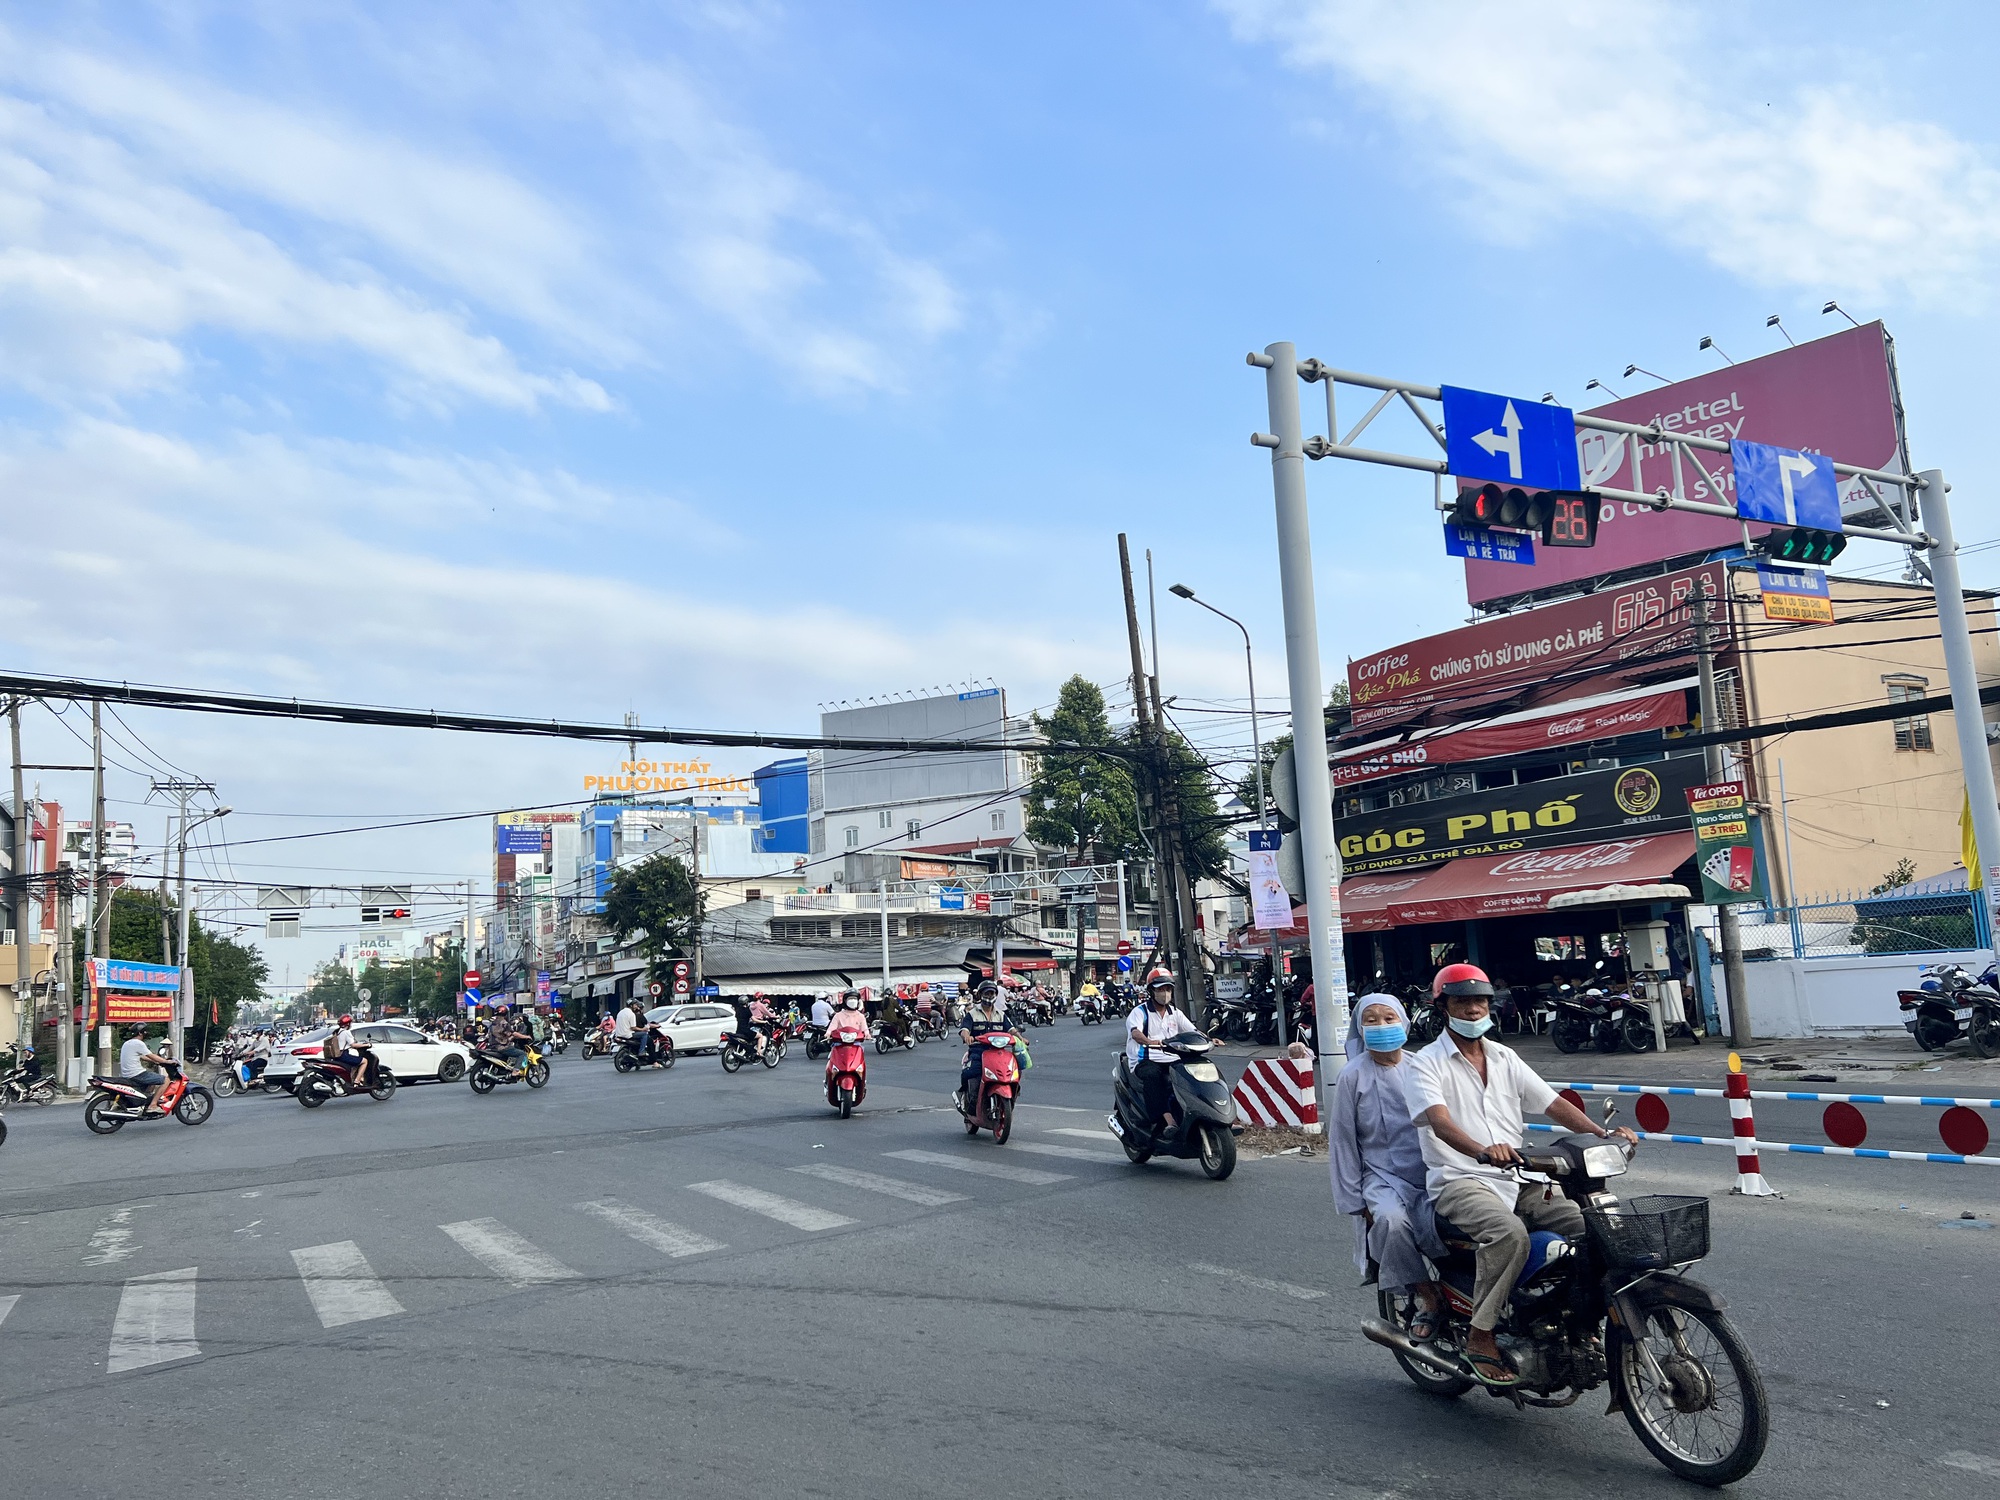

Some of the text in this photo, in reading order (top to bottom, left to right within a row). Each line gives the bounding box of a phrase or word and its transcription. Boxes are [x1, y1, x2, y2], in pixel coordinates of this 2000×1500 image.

[1552, 499, 1588, 540] 26
[1497, 547, 1517, 561] TRÁI
[1429, 657, 1472, 682] CHÚNG
[1473, 649, 1493, 671] TÔI
[1496, 643, 1512, 666] SỬ
[1514, 638, 1551, 664] DỤNG
[1554, 629, 1576, 652] CÀ
[1578, 621, 1604, 646] PHÊ
[1612, 586, 1665, 638] Già
[1357, 653, 1409, 681] Coffee
[1355, 667, 1422, 704] Góc Phố
[1595, 716, 1617, 728] Real
[1619, 710, 1651, 723] Magic
[621, 756, 711, 776] NỘI THẤT
[694, 773, 750, 792] TRÚC
[1708, 785, 1738, 797] OPPO
[1339, 828, 1426, 858] Góc
[1446, 793, 1584, 841] Phố
[1696, 811, 1744, 825] Reno Series
[1709, 825, 1717, 835] 3
[1717, 823, 1743, 834] TRIỆU
[1354, 861, 1367, 873] SỬ
[1368, 858, 1404, 871] DỤNG
[1406, 853, 1430, 864] CÀ
[1432, 849, 1460, 861] PHÊ
[1463, 844, 1495, 856] GIÀ
[1498, 840, 1524, 851] RÔ
[1483, 898, 1510, 907] COFFEE
[360, 940, 393, 948] HAGL
